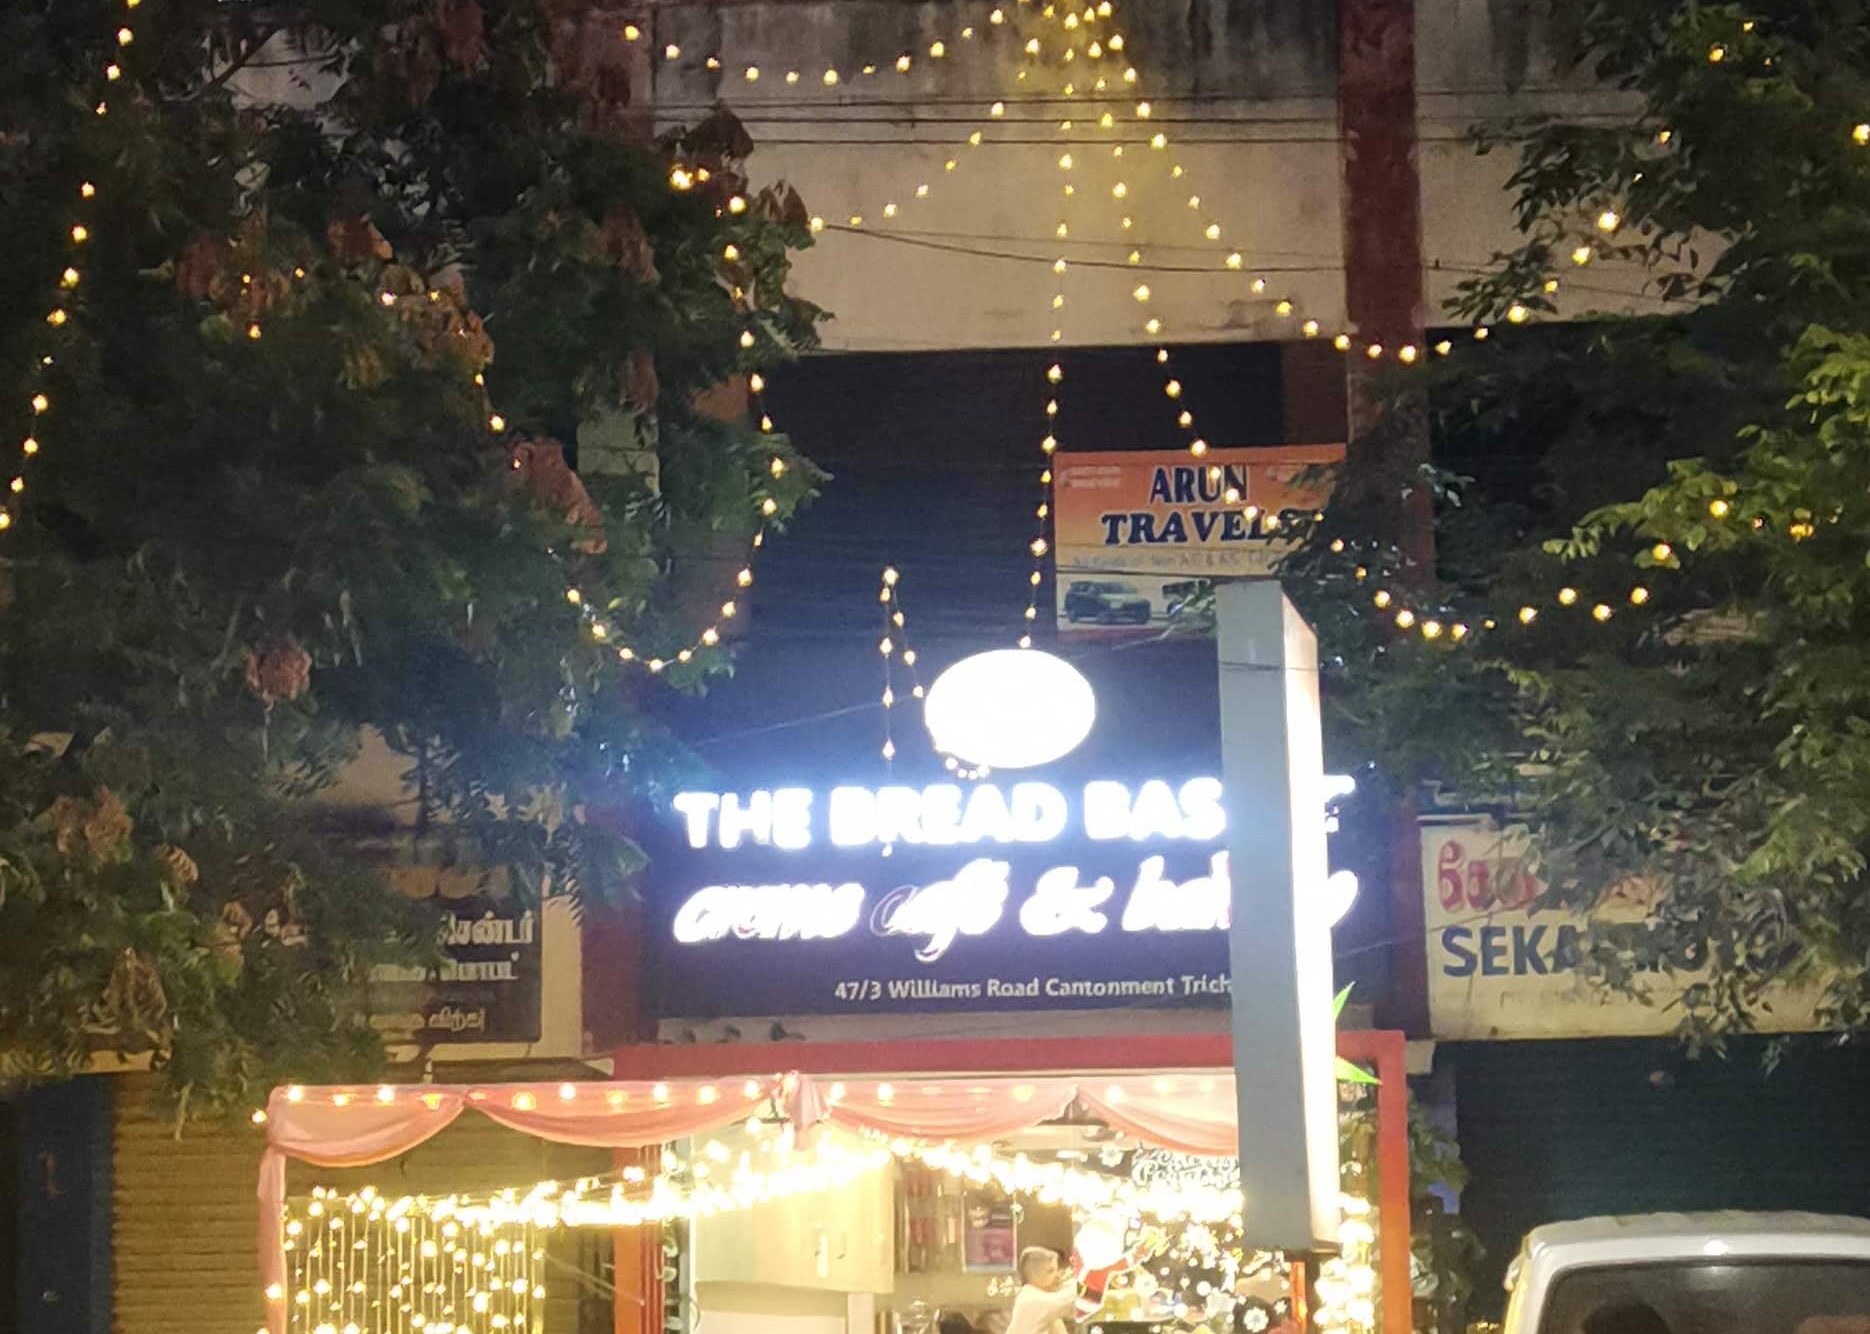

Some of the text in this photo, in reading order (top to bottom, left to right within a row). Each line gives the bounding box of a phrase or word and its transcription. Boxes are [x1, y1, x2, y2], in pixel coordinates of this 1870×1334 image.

[1149, 463, 1248, 503] ARUN
[673, 787, 814, 848] THE
[828, 782, 1068, 845] BREAD
[1019, 866, 1114, 936] &
[834, 972, 1232, 1001] 47/3 Williams Road Cantonment Trich
